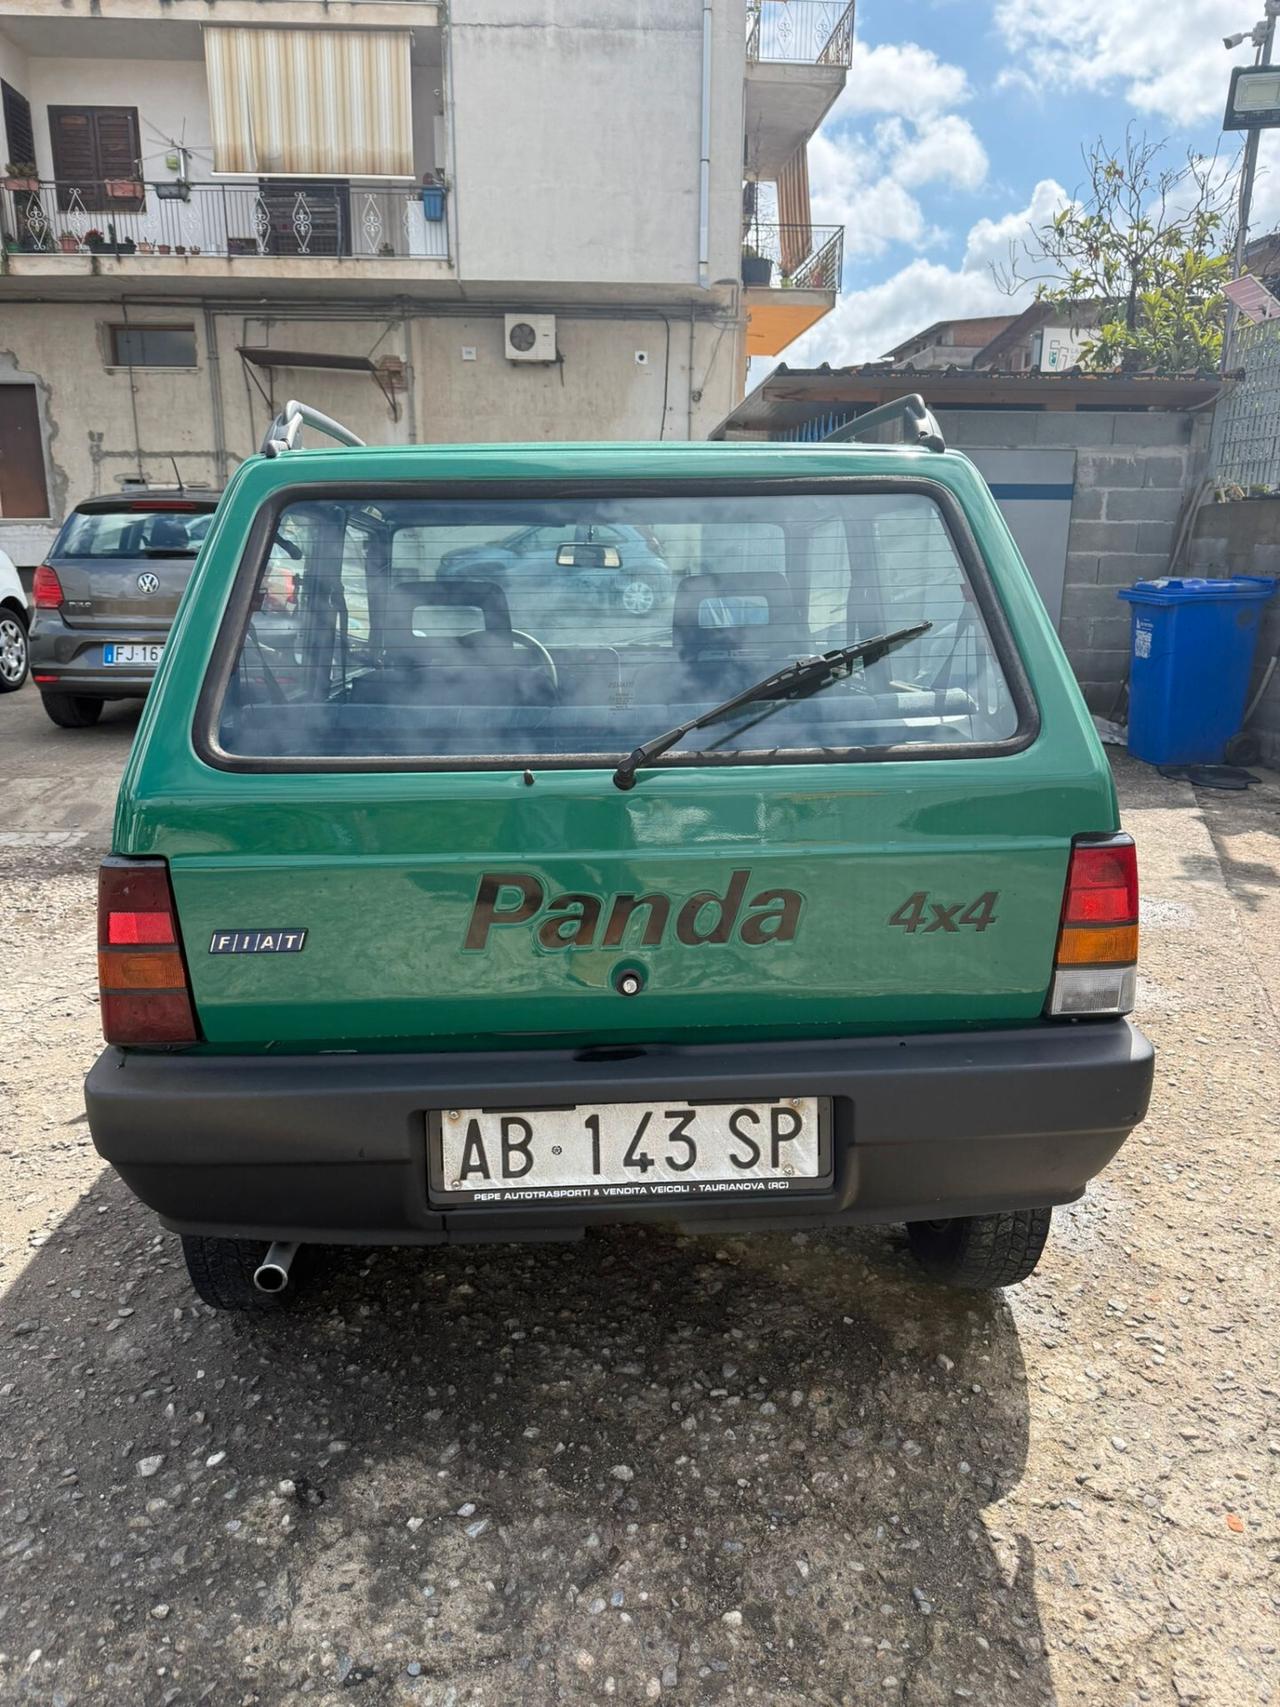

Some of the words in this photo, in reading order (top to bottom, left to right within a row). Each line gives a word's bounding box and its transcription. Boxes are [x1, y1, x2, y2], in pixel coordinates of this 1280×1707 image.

[462, 867, 804, 951] Panda
[888, 891, 1000, 933] 4x4
[217, 935, 299, 950] FIAT
[459, 1116, 534, 1181] AB
[585, 1109, 697, 1175] 143
[728, 1106, 803, 1170] SP
[474, 1192, 501, 1201] PEPE
[504, 1188, 590, 1200] AUTOTRASPORTI
[593, 1188, 600, 1196] &
[602, 1186, 647, 1196] VENDITA
[650, 1184, 690, 1194] VEICOLI
[699, 1182, 765, 1192] TAURIANOVA
[768, 1181, 789, 1190] (RC)
